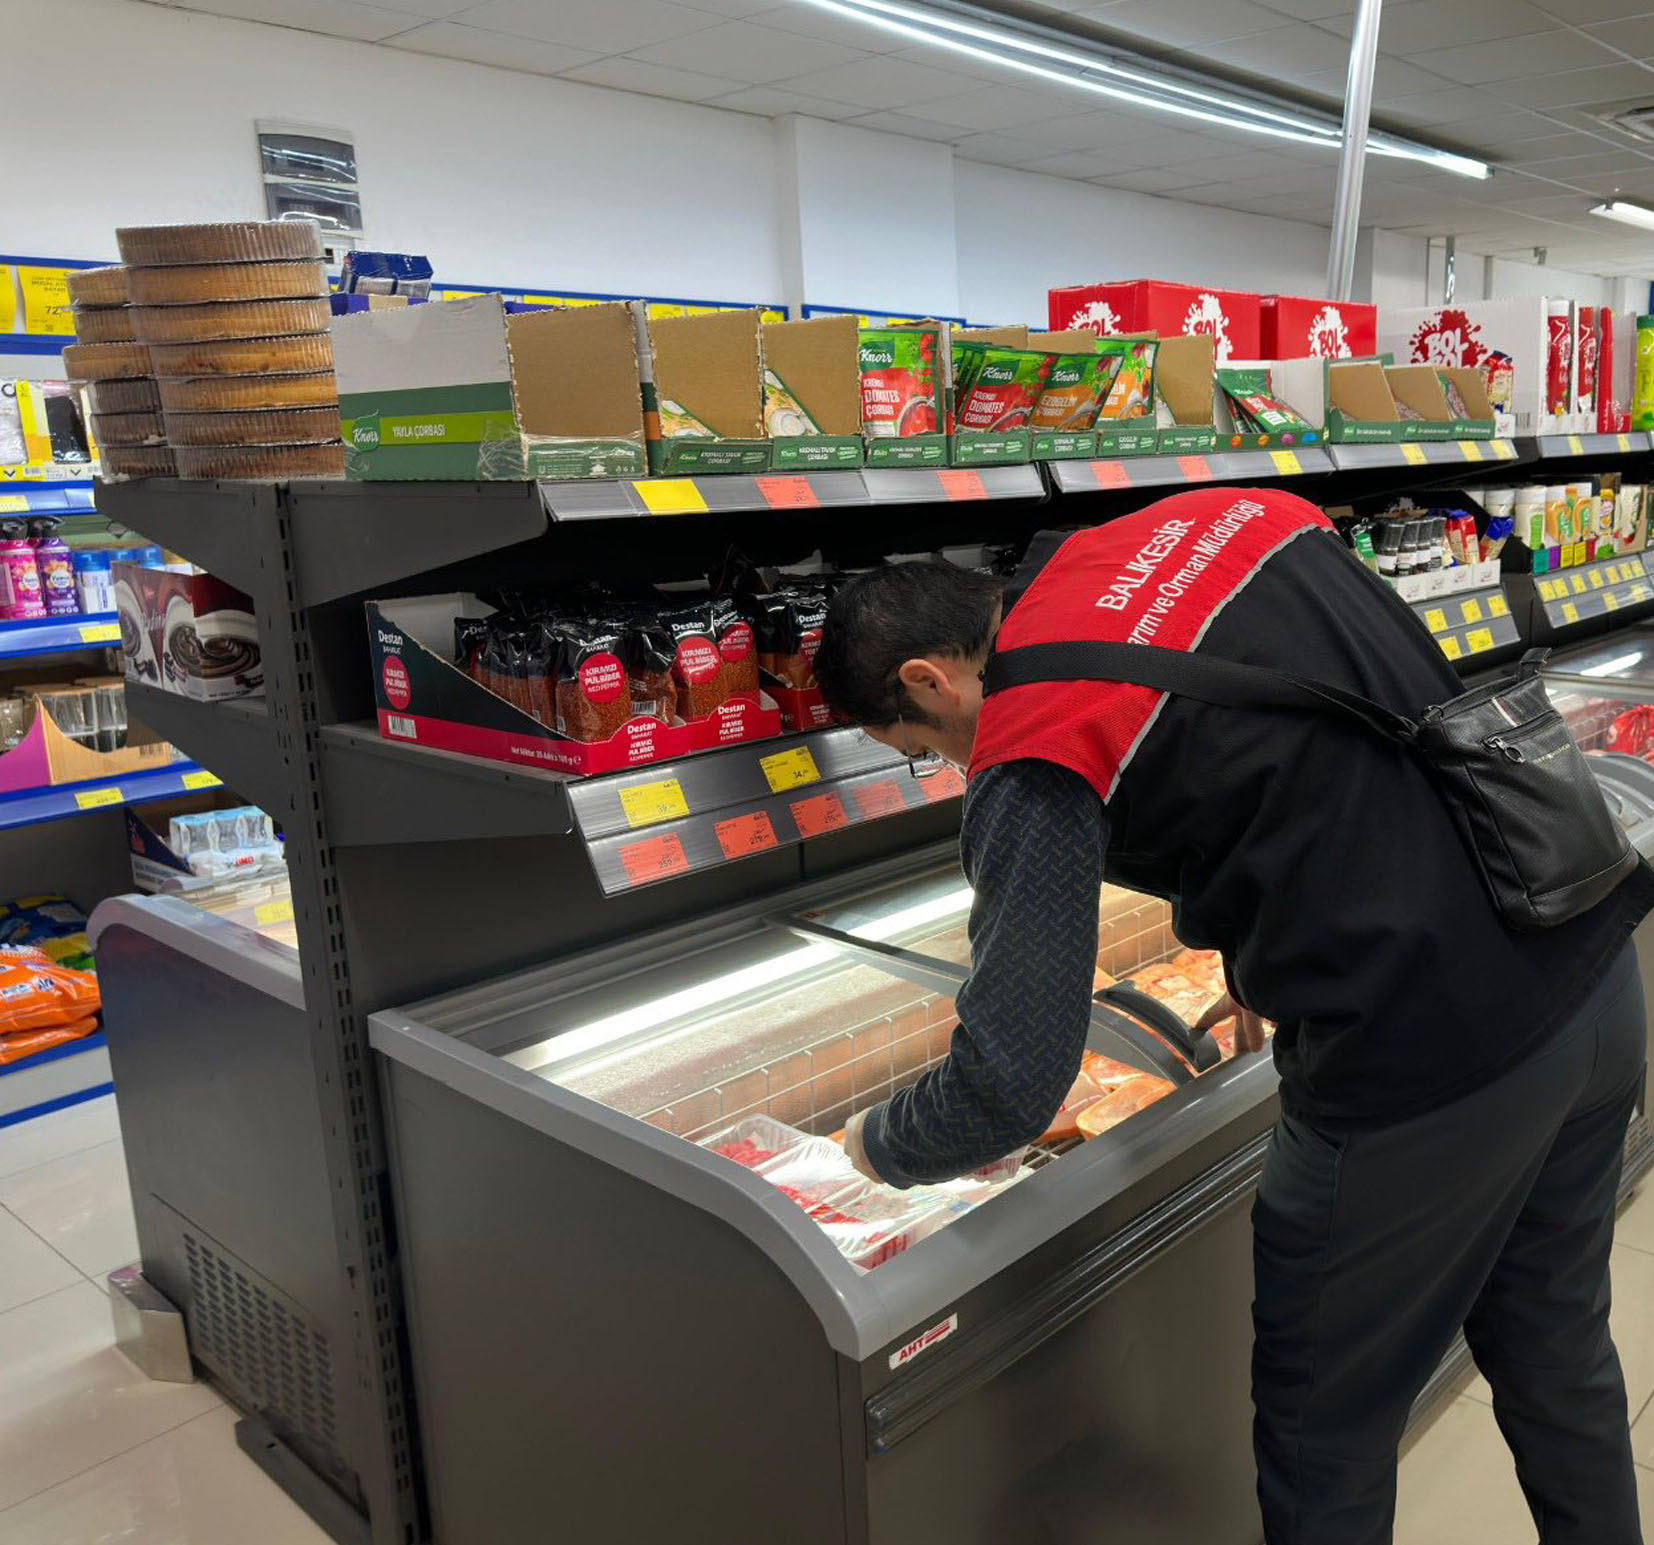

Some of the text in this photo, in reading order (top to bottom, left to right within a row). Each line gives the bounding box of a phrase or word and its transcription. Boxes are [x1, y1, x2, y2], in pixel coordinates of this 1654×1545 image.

[1320, 329, 1341, 350] BOL
[1424, 327, 1470, 355] BOL
[860, 348, 893, 364] Knorr
[982, 366, 1014, 381] Knorr
[1051, 370, 1080, 383] Knorr
[353, 427, 379, 445] Knorr
[392, 424, 446, 440] YAYLA ÇORBASI
[1095, 517, 1198, 611] BALIKESİR
[1127, 498, 1267, 646] arım ve Orman Müdürlüğü
[671, 621, 705, 633] Destan
[799, 613, 827, 625] Destan
[378, 630, 403, 646] Destan
[585, 664, 618, 676] KIRMIZI
[717, 703, 745, 715] Destan
[627, 721, 657, 734] Destan
[899, 1337, 925, 1361] AHT
